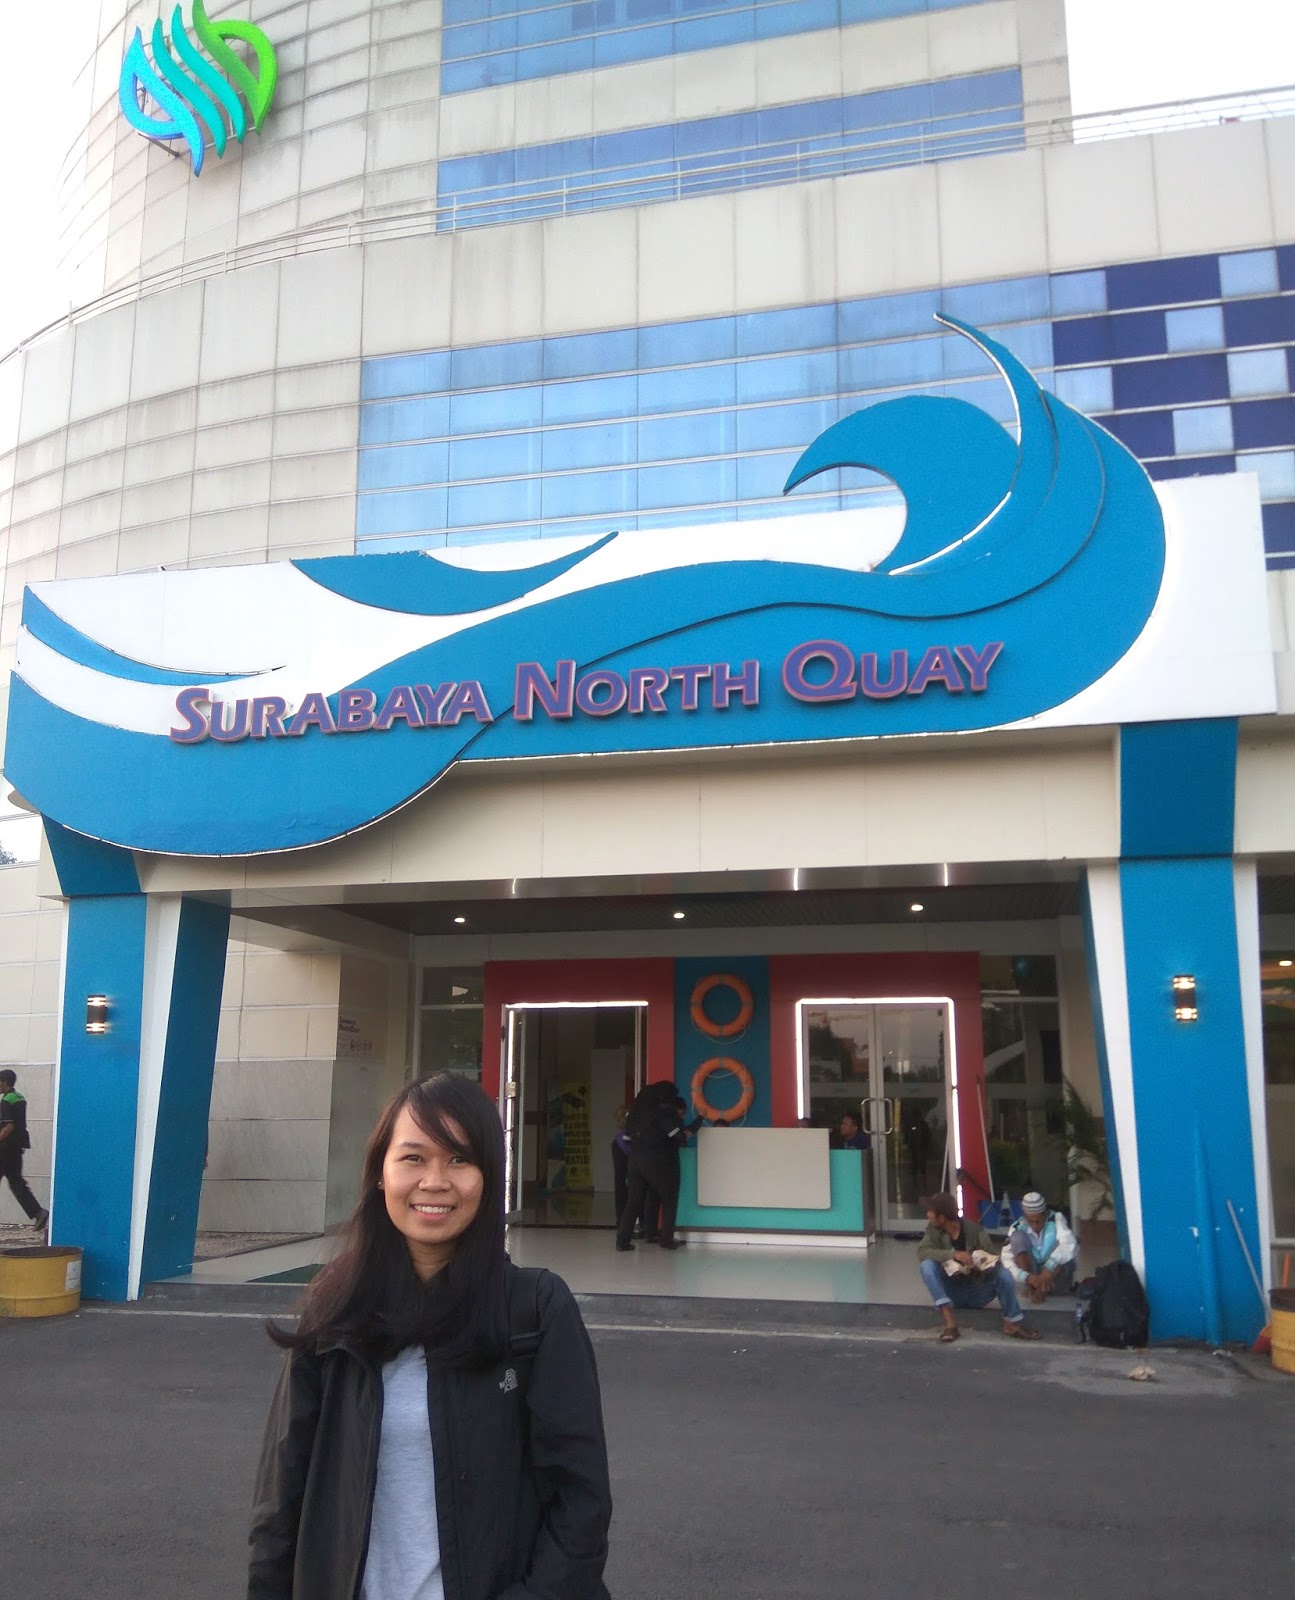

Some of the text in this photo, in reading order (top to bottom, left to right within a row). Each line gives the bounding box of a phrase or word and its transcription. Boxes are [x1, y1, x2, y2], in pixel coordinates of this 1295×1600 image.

[170, 639, 1004, 744] SURABAYA NORTH QUAY
